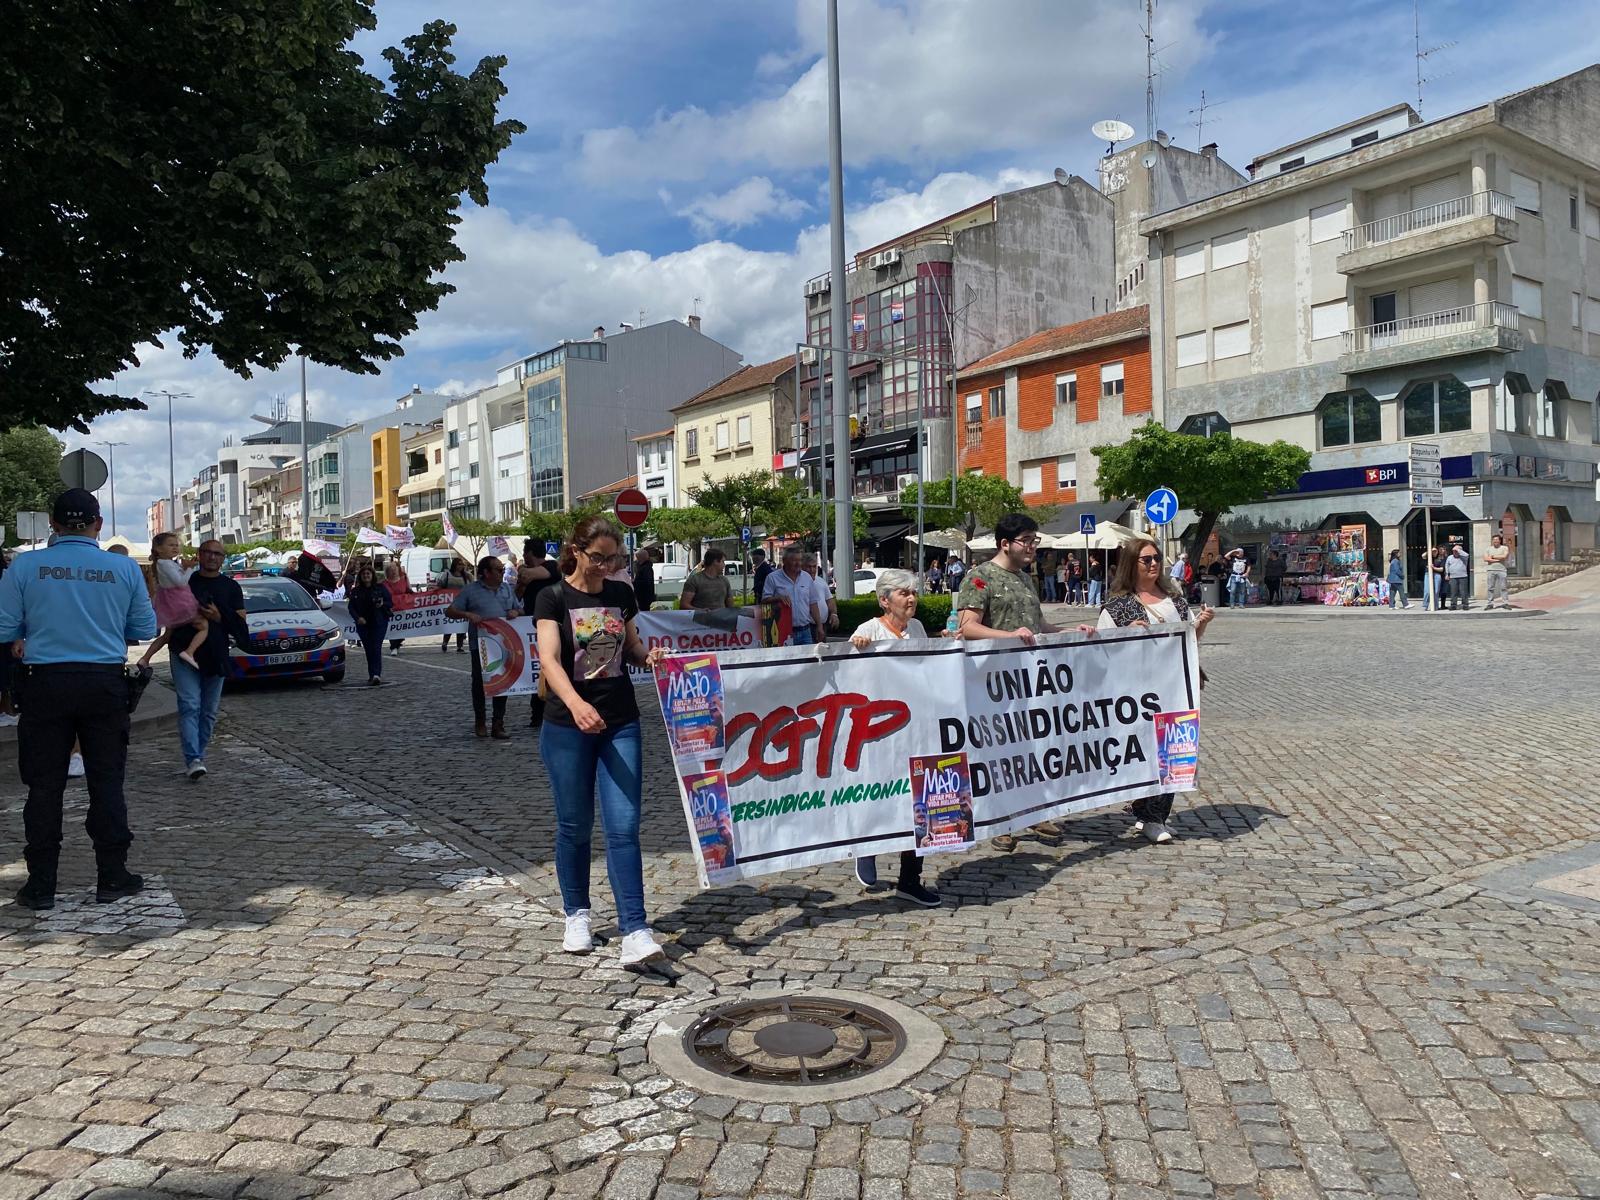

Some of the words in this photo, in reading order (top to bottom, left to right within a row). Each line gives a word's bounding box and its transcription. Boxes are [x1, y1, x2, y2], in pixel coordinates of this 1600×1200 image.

[1380, 469, 1397, 480] BPI
[39, 566, 116, 583] POLÍCIA
[414, 593, 454, 608] STFPSN
[247, 618, 313, 627] OLICIA
[406, 610, 423, 620] DOS
[648, 635, 672, 649] DO
[986, 659, 1074, 702] UNIÃO
[705, 692, 911, 787] CGTP
[831, 778, 911, 807] NACIONAL
